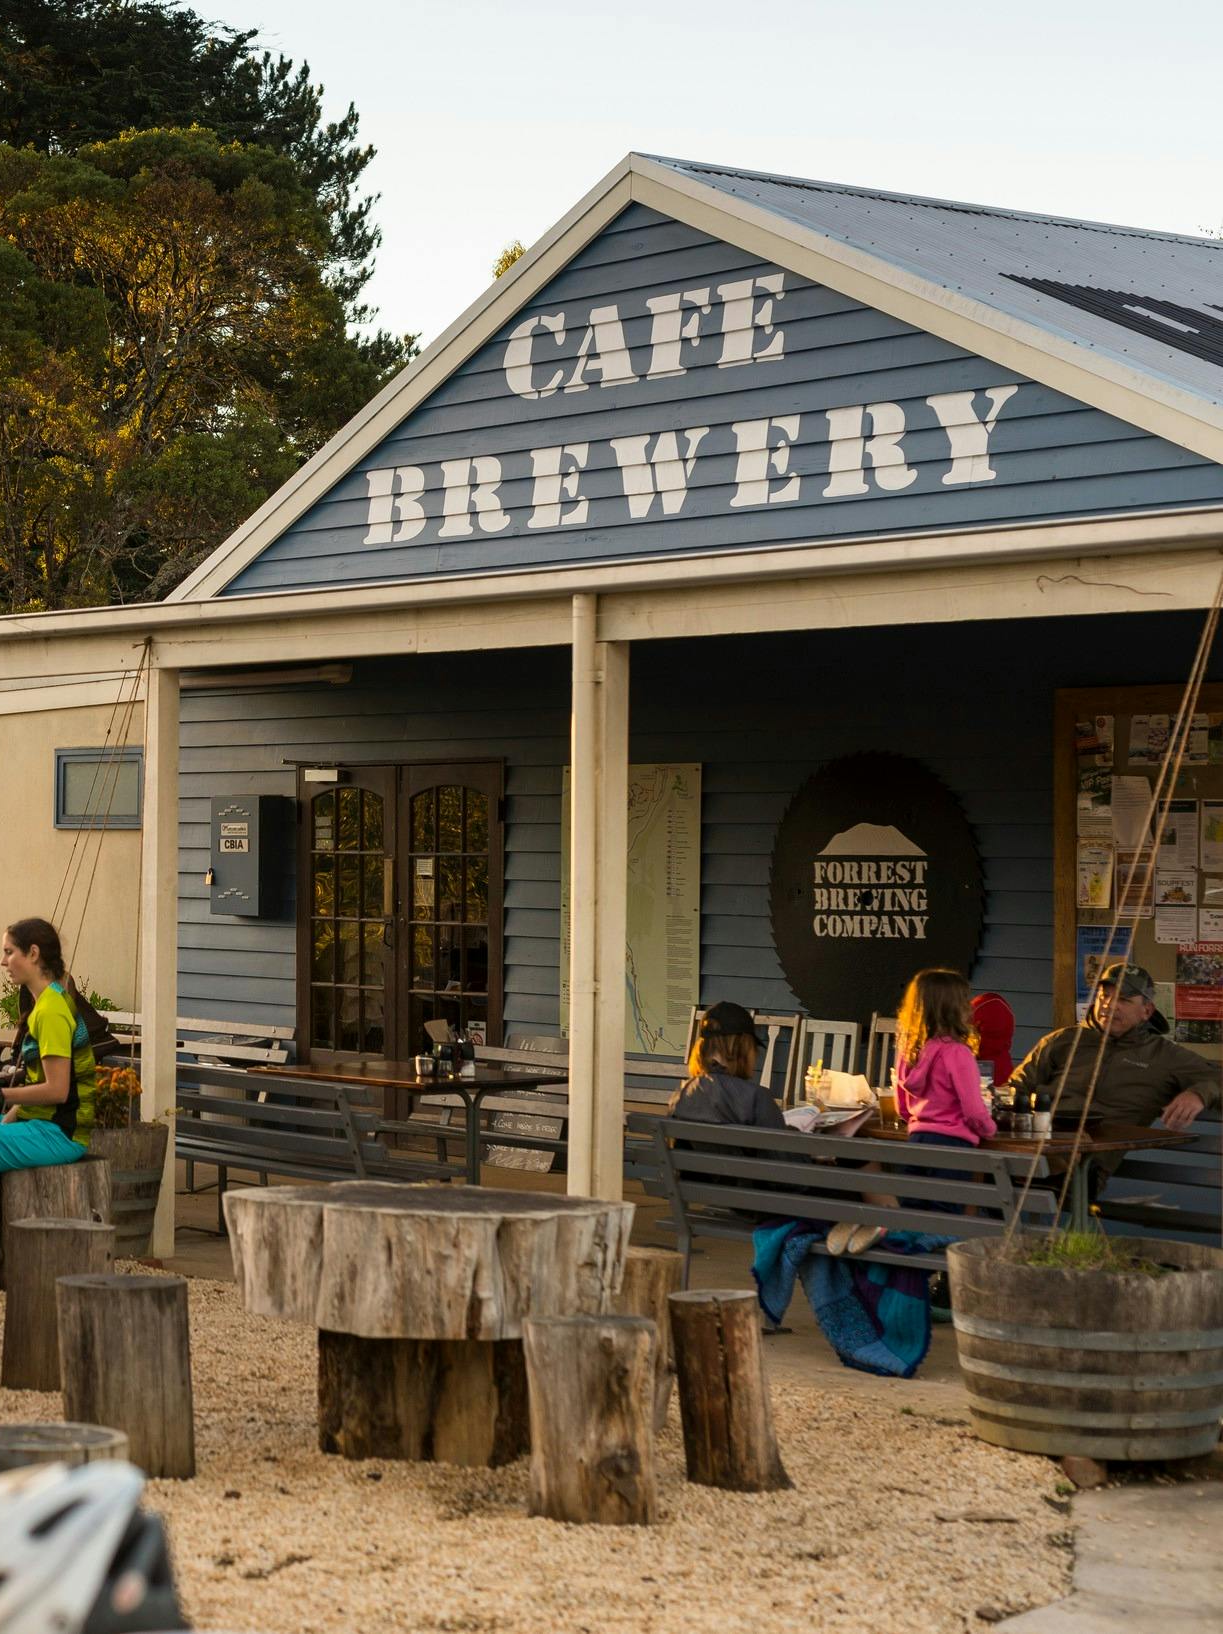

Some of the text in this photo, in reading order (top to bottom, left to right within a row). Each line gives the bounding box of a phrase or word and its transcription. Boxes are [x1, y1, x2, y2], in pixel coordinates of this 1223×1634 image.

[503, 273, 785, 399] CAFE
[363, 385, 1019, 544] BREWERY
[224, 839, 244, 849] CBIA
[813, 861, 928, 884] FORREST
[813, 915, 929, 939] COMPANY
